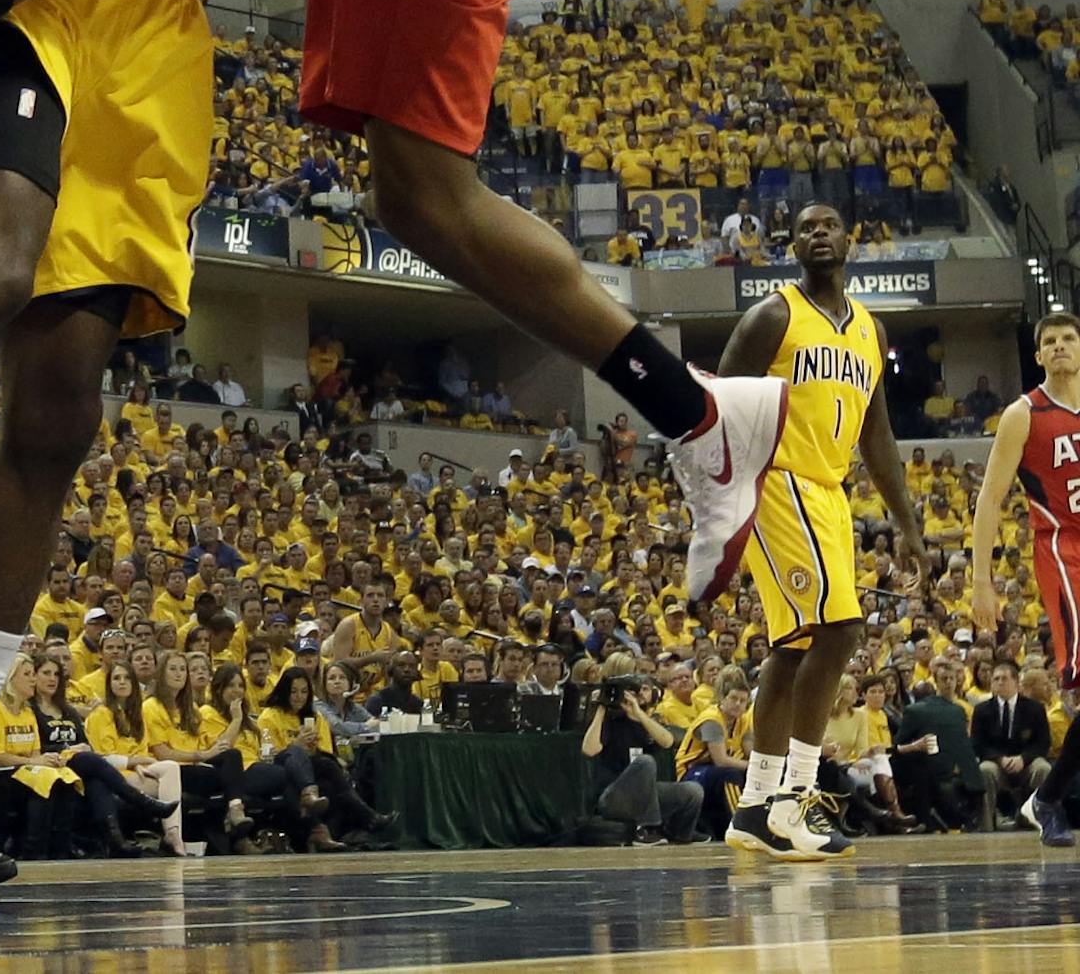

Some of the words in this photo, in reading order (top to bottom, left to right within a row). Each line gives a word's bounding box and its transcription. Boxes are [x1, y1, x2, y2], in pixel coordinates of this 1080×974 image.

[632, 193, 698, 244] 33
[845, 274, 930, 293] APHICS
[792, 346, 871, 399] INDIANA
[832, 398, 843, 439] 1
